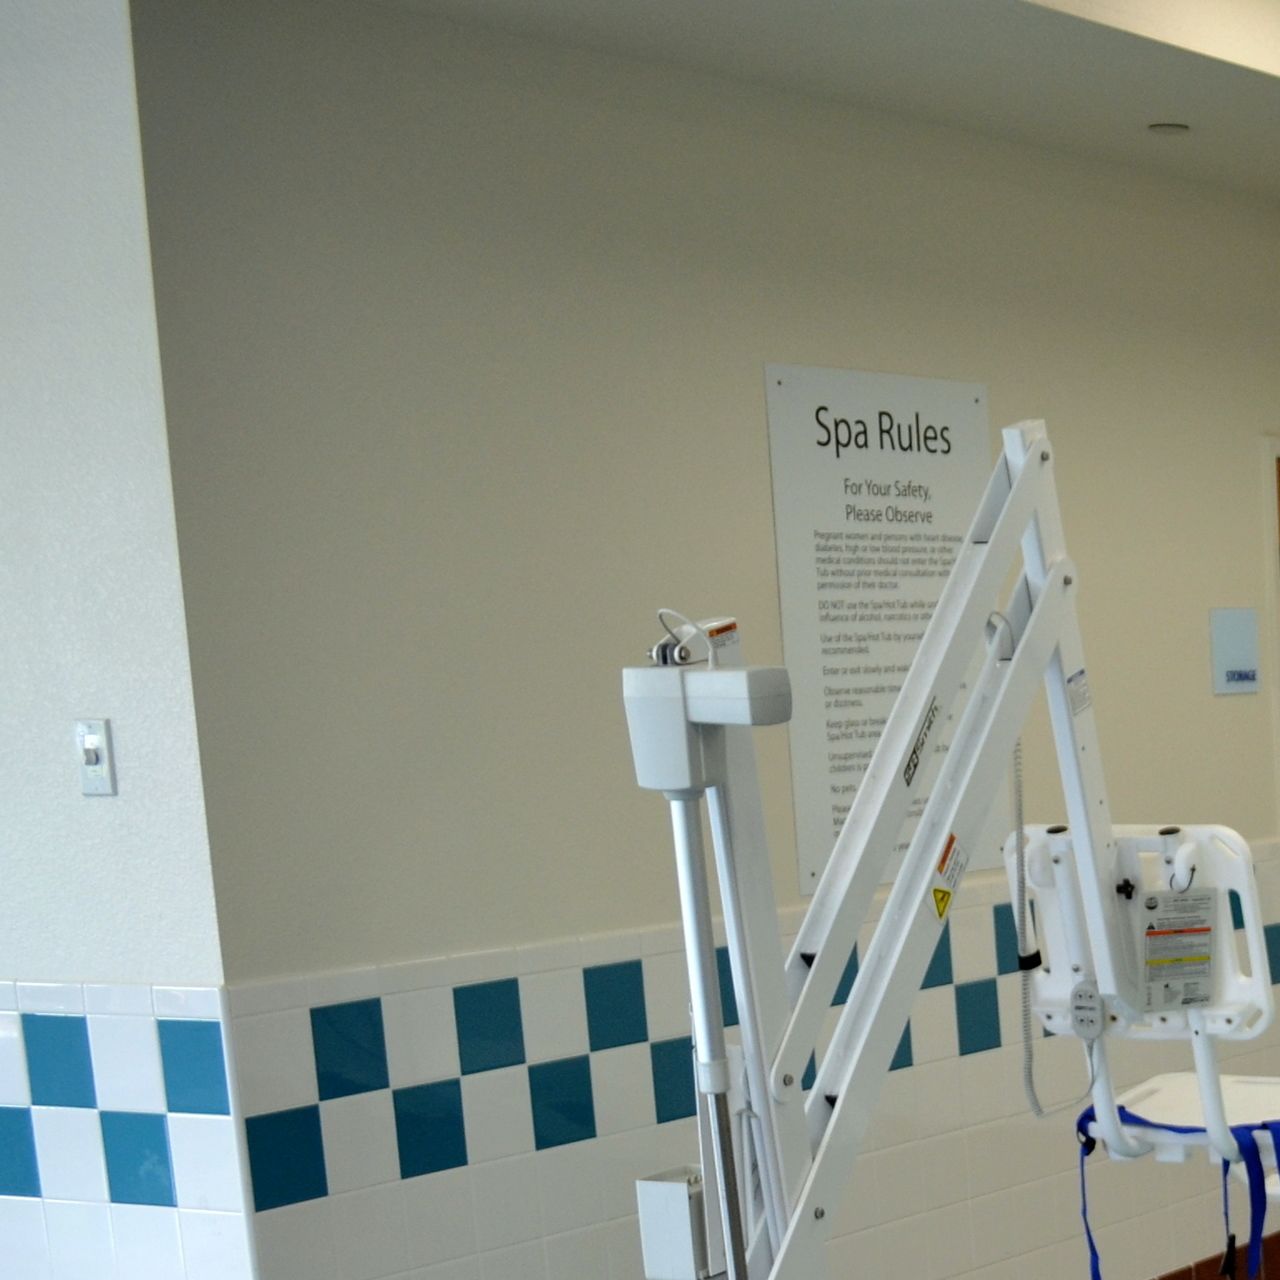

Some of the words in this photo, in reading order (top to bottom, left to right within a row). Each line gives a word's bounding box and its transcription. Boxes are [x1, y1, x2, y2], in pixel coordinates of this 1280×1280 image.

[815, 405, 869, 459] Spa
[878, 411, 952, 456] Rules
[844, 478, 862, 497] For
[864, 479, 892, 498] Your
[894, 480, 932, 502] Safety,
[845, 504, 883, 523] Please
[885, 505, 934, 525] Observe
